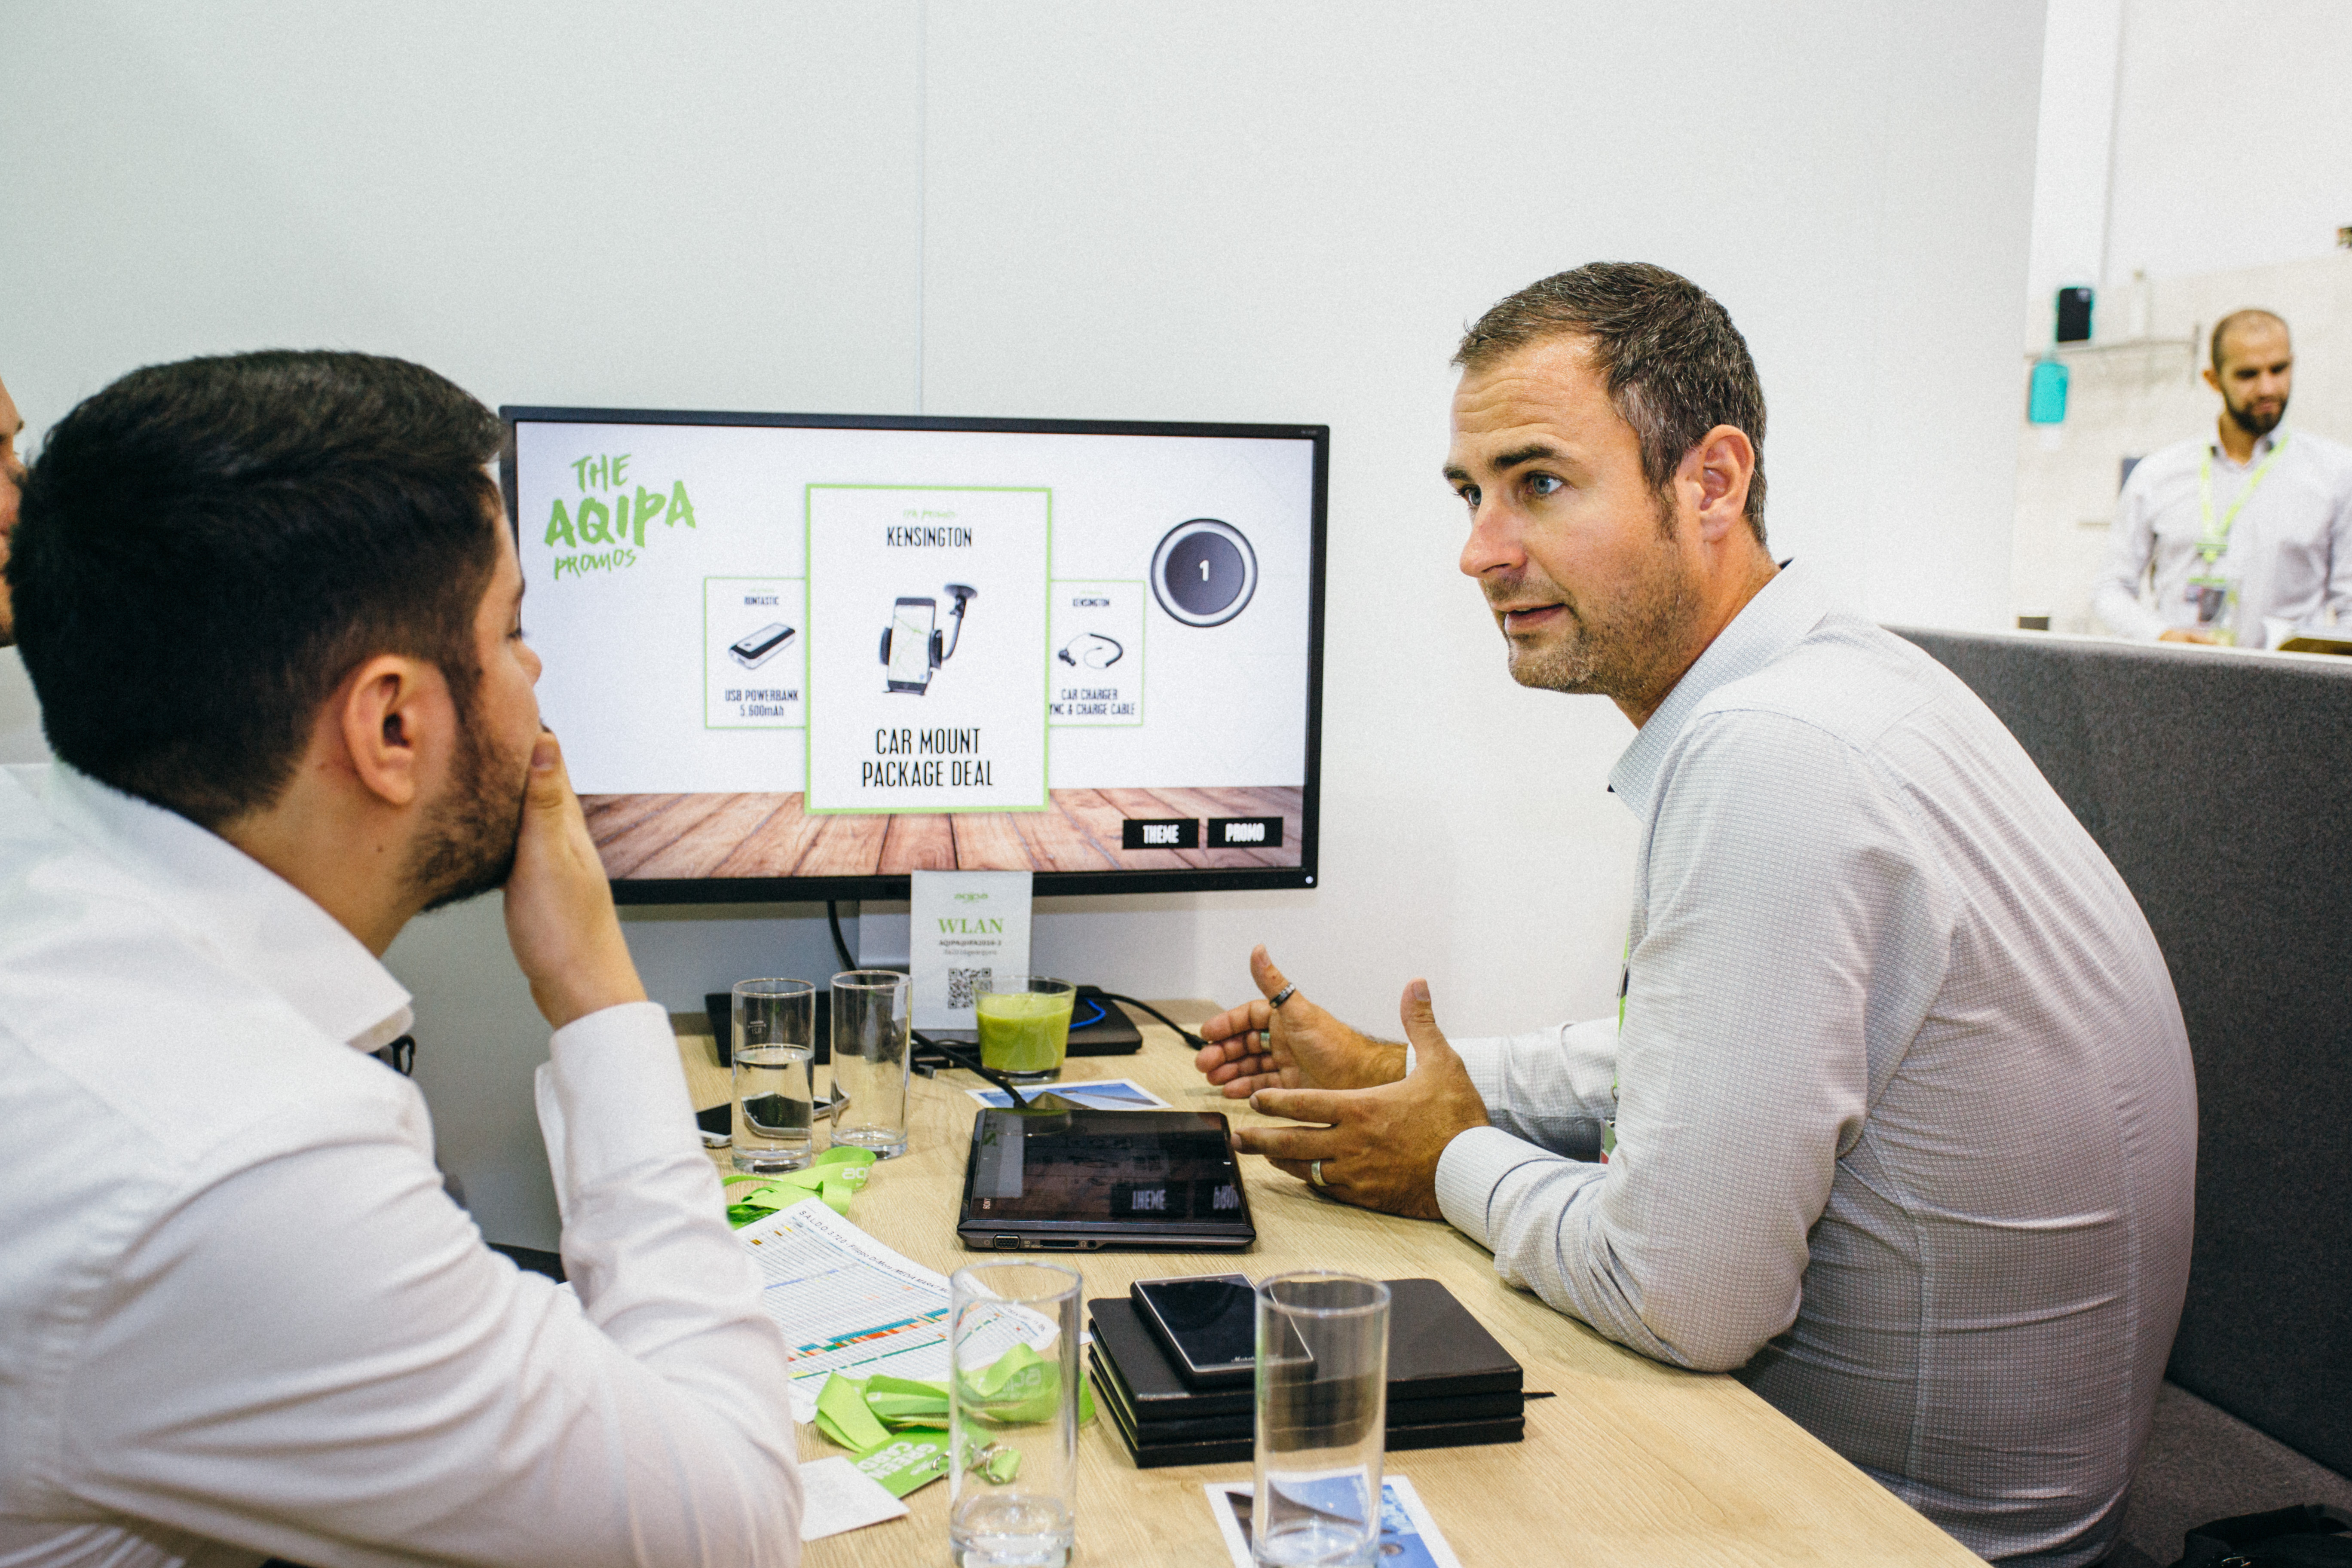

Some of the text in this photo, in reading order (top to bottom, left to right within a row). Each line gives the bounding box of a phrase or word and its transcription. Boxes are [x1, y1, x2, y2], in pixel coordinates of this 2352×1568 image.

[570, 453, 631, 493] THE
[545, 480, 696, 548] AQIPA
[887, 526, 972, 547] KENSINGTON
[554, 548, 637, 580] PROMOS
[1199, 560, 1210, 582] 1
[725, 689, 798, 701] USB POWERBANK
[1062, 689, 1118, 701] CAR CHARGER
[1076, 704, 1107, 715] CHARGE
[1111, 703, 1135, 715] CABLE
[876, 729, 980, 754] CAR MOUNT
[862, 761, 992, 787] PACKAGE DEAL
[1143, 824, 1179, 844] THEME
[1225, 823, 1265, 842] PROMO
[937, 918, 1004, 934] WLAN
[983, 1197, 991, 1210] SONY
